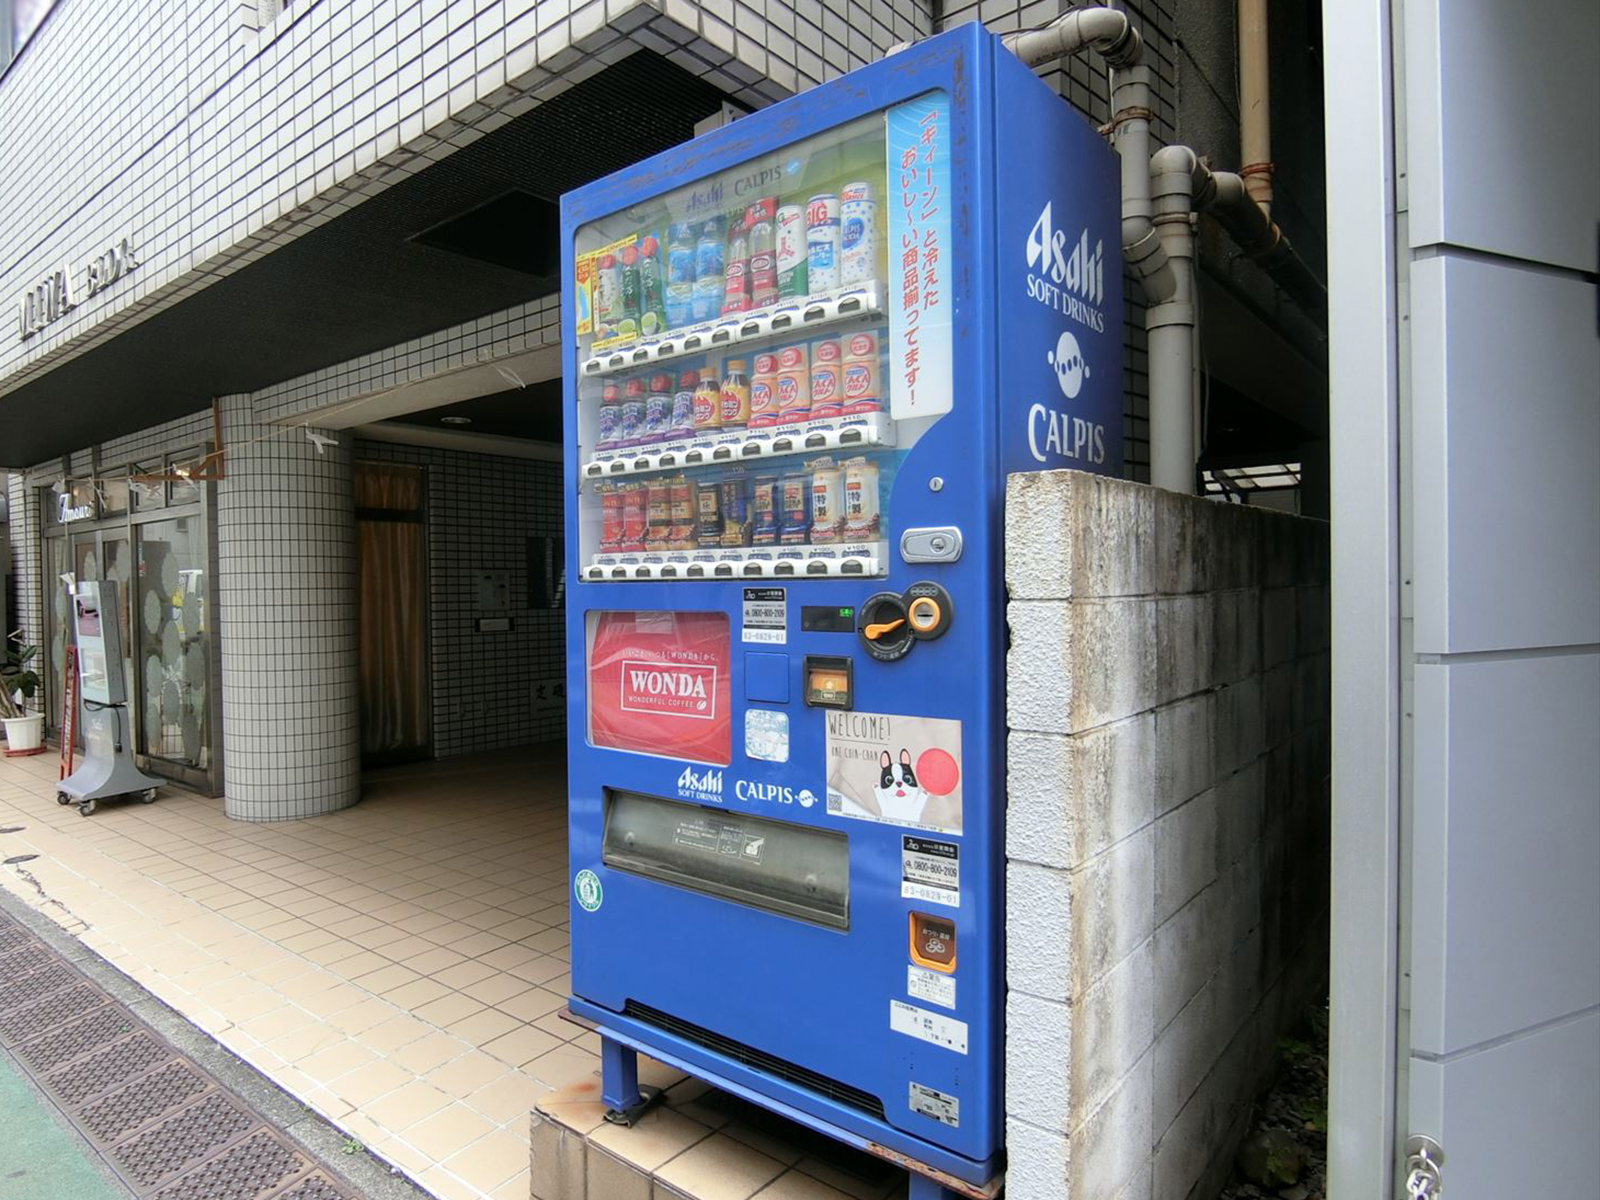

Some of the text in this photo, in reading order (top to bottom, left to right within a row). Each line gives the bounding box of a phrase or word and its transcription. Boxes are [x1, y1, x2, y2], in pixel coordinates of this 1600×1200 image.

[734, 165, 782, 196] CALPIS
[1026, 200, 1104, 307] Asahi
[1026, 273, 1105, 334] SOFT DRINKS
[1027, 403, 1106, 465] CALPIS
[629, 669, 707, 699] WONDA
[627, 696, 694, 708] WONDERFUL COFFEE
[828, 713, 891, 741] WELCOME!
[677, 766, 793, 804] Asahi CALPIS
[677, 788, 723, 803] SOFT DRINKS
